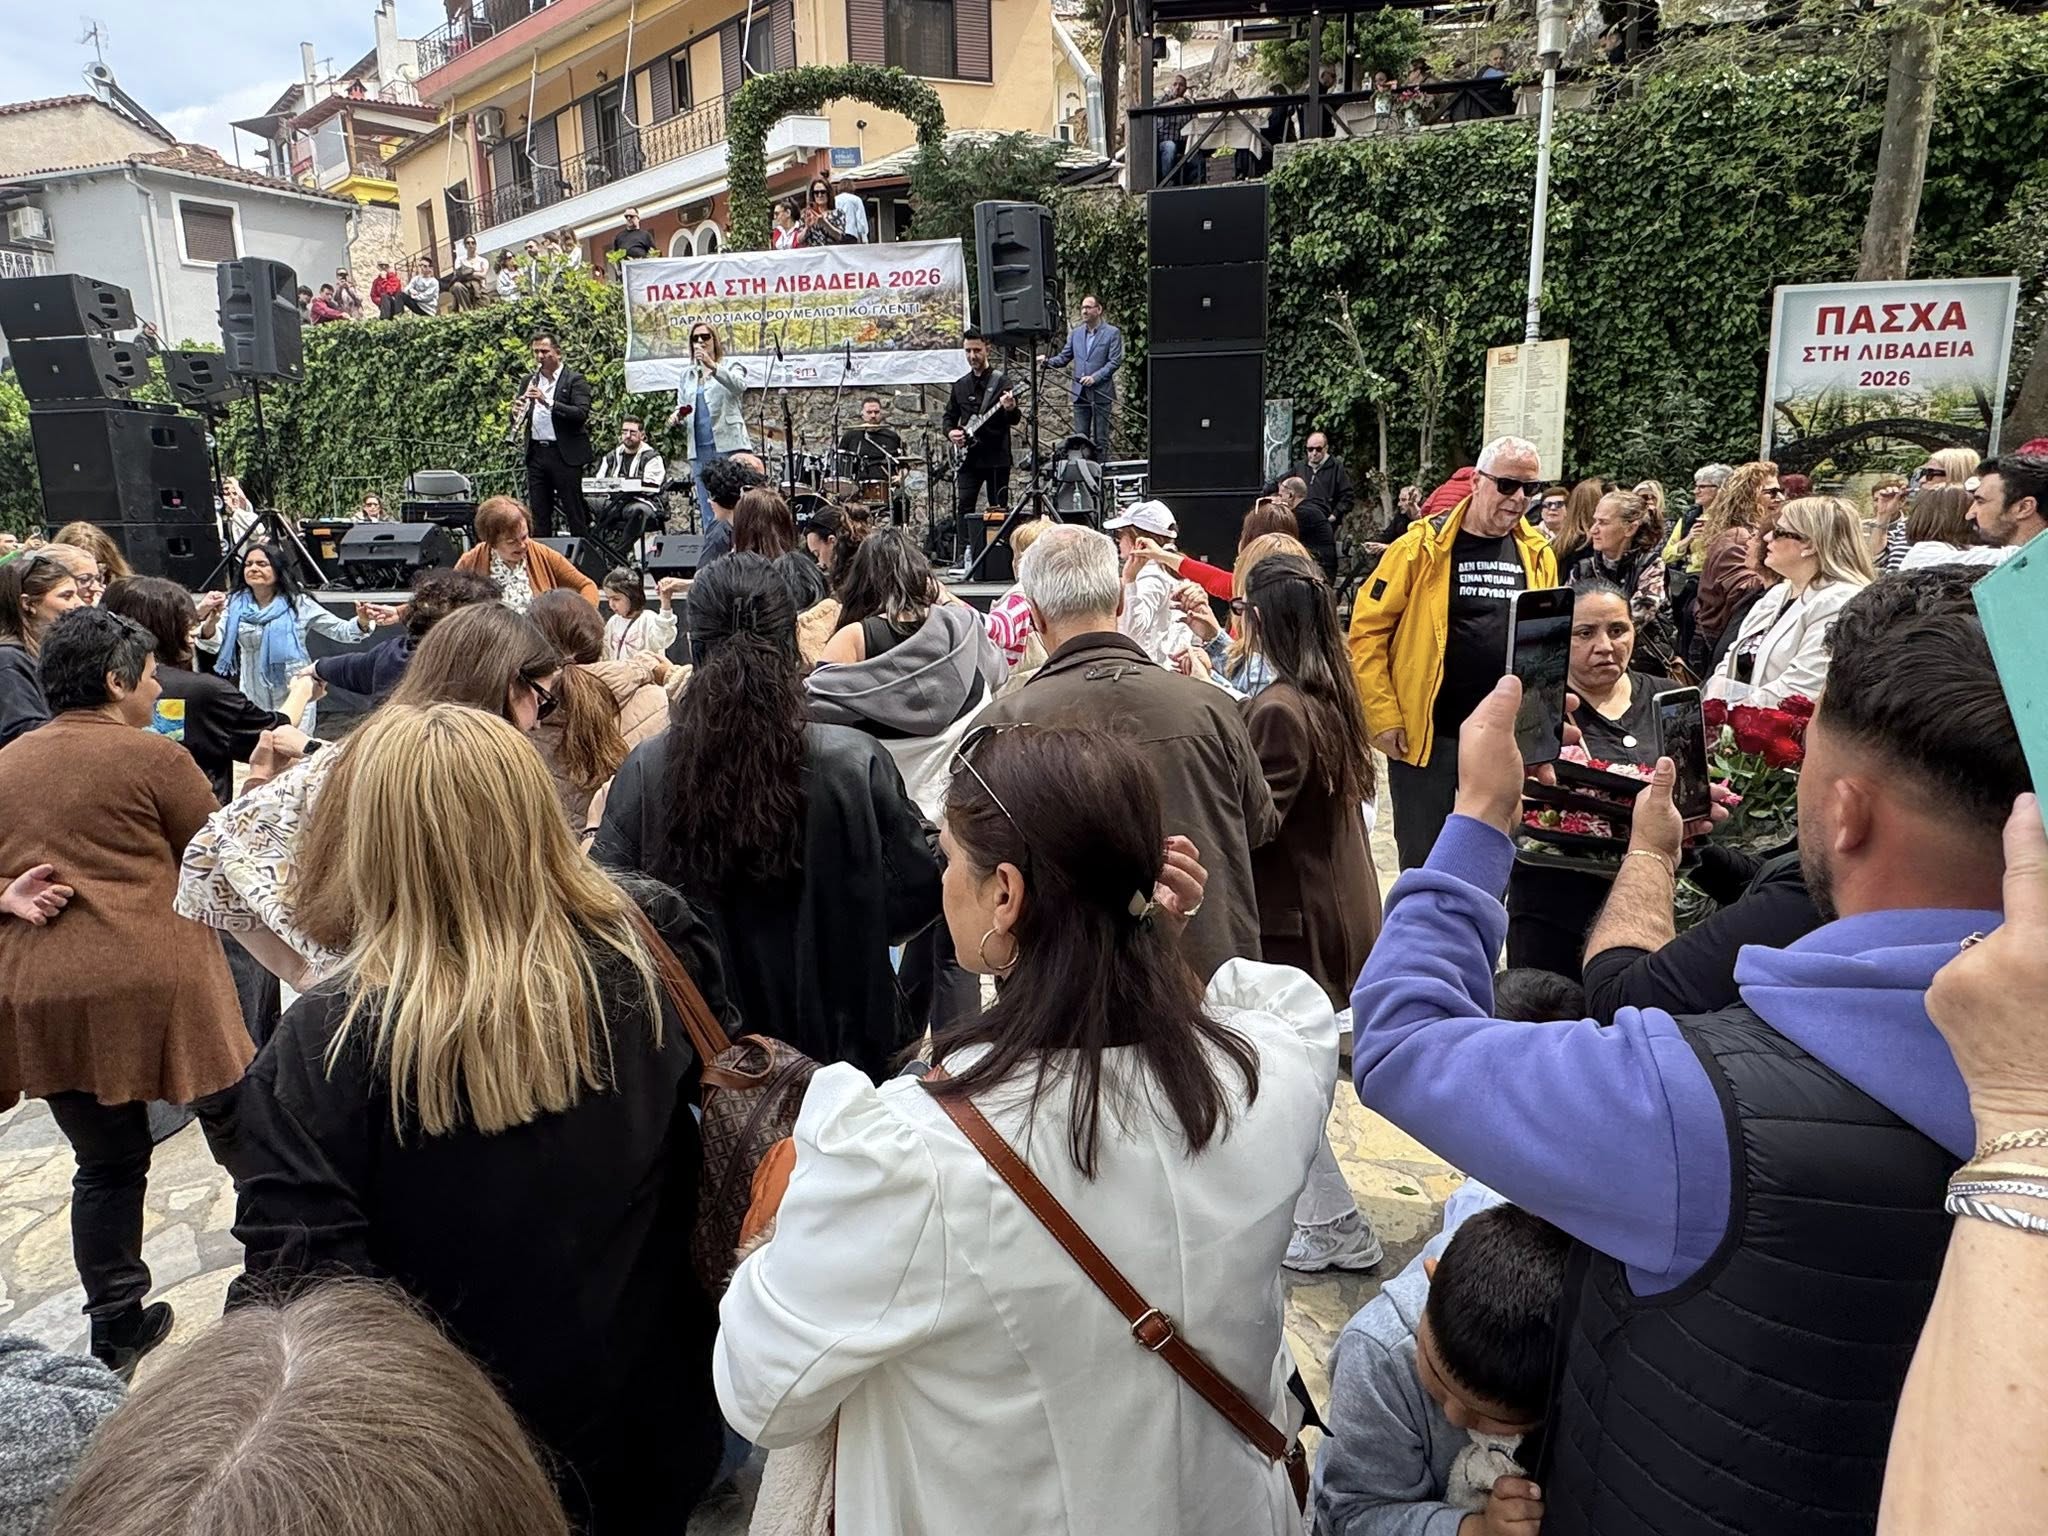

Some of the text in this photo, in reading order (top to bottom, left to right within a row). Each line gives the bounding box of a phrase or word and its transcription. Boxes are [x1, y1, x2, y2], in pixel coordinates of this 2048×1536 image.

[647, 268, 941, 302] ΠΑΣΧΑ ΣΤΗ ΛΙΒΑΔΕΙΑ 2026
[766, 305, 868, 320] ΡΟΥΜΕΛΙΩΤΙΚΟ
[872, 303, 920, 315] ΓΛΕΝΤΙ
[1816, 301, 1967, 336] ΠΑΣΧΑ
[1802, 340, 1975, 363] ΣΤΗ ΛΙΒΑΔΕΙΑ
[1859, 370, 1911, 387] 2026
[1458, 562, 1475, 572] ΔΕΝ
[1459, 574, 1482, 583] ΕΙΝΑΙ
[1459, 586, 1477, 596] ΠΟΥ
